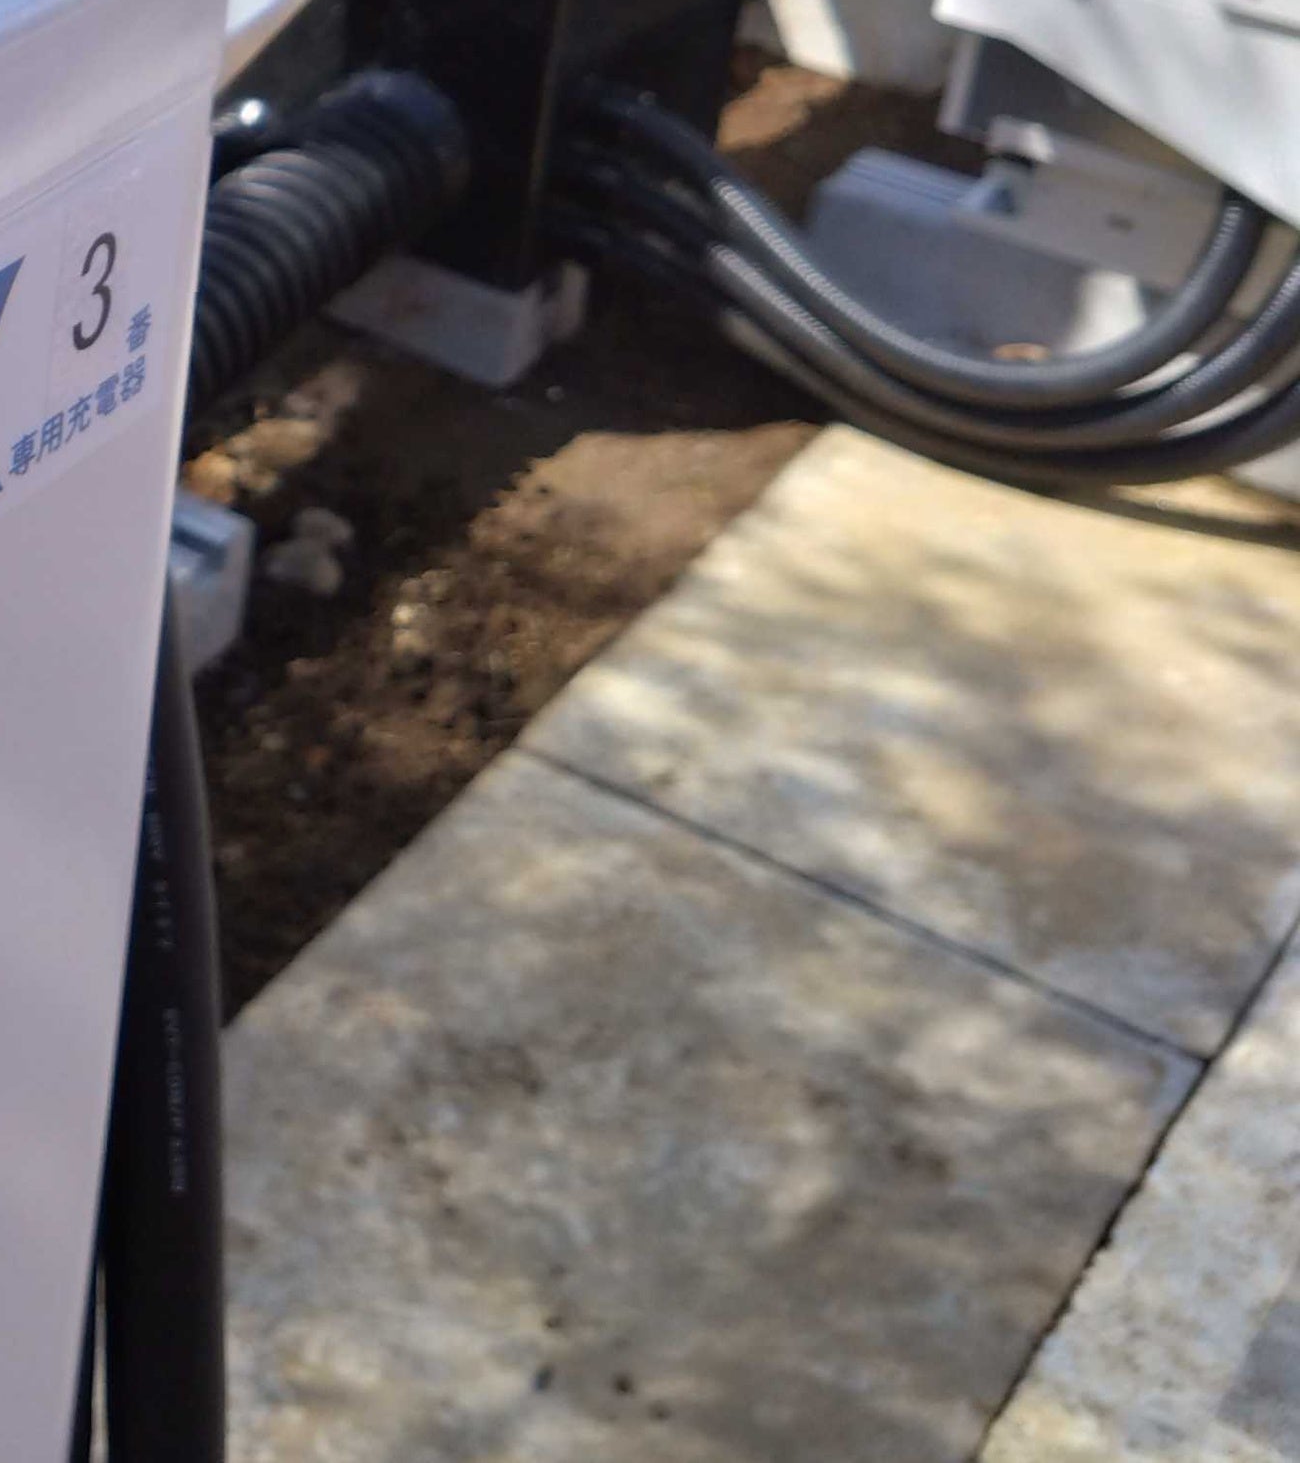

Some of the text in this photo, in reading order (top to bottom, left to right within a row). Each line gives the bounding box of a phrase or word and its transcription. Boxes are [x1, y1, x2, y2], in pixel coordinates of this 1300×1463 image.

[8, 354, 148, 477] 専用充電器
